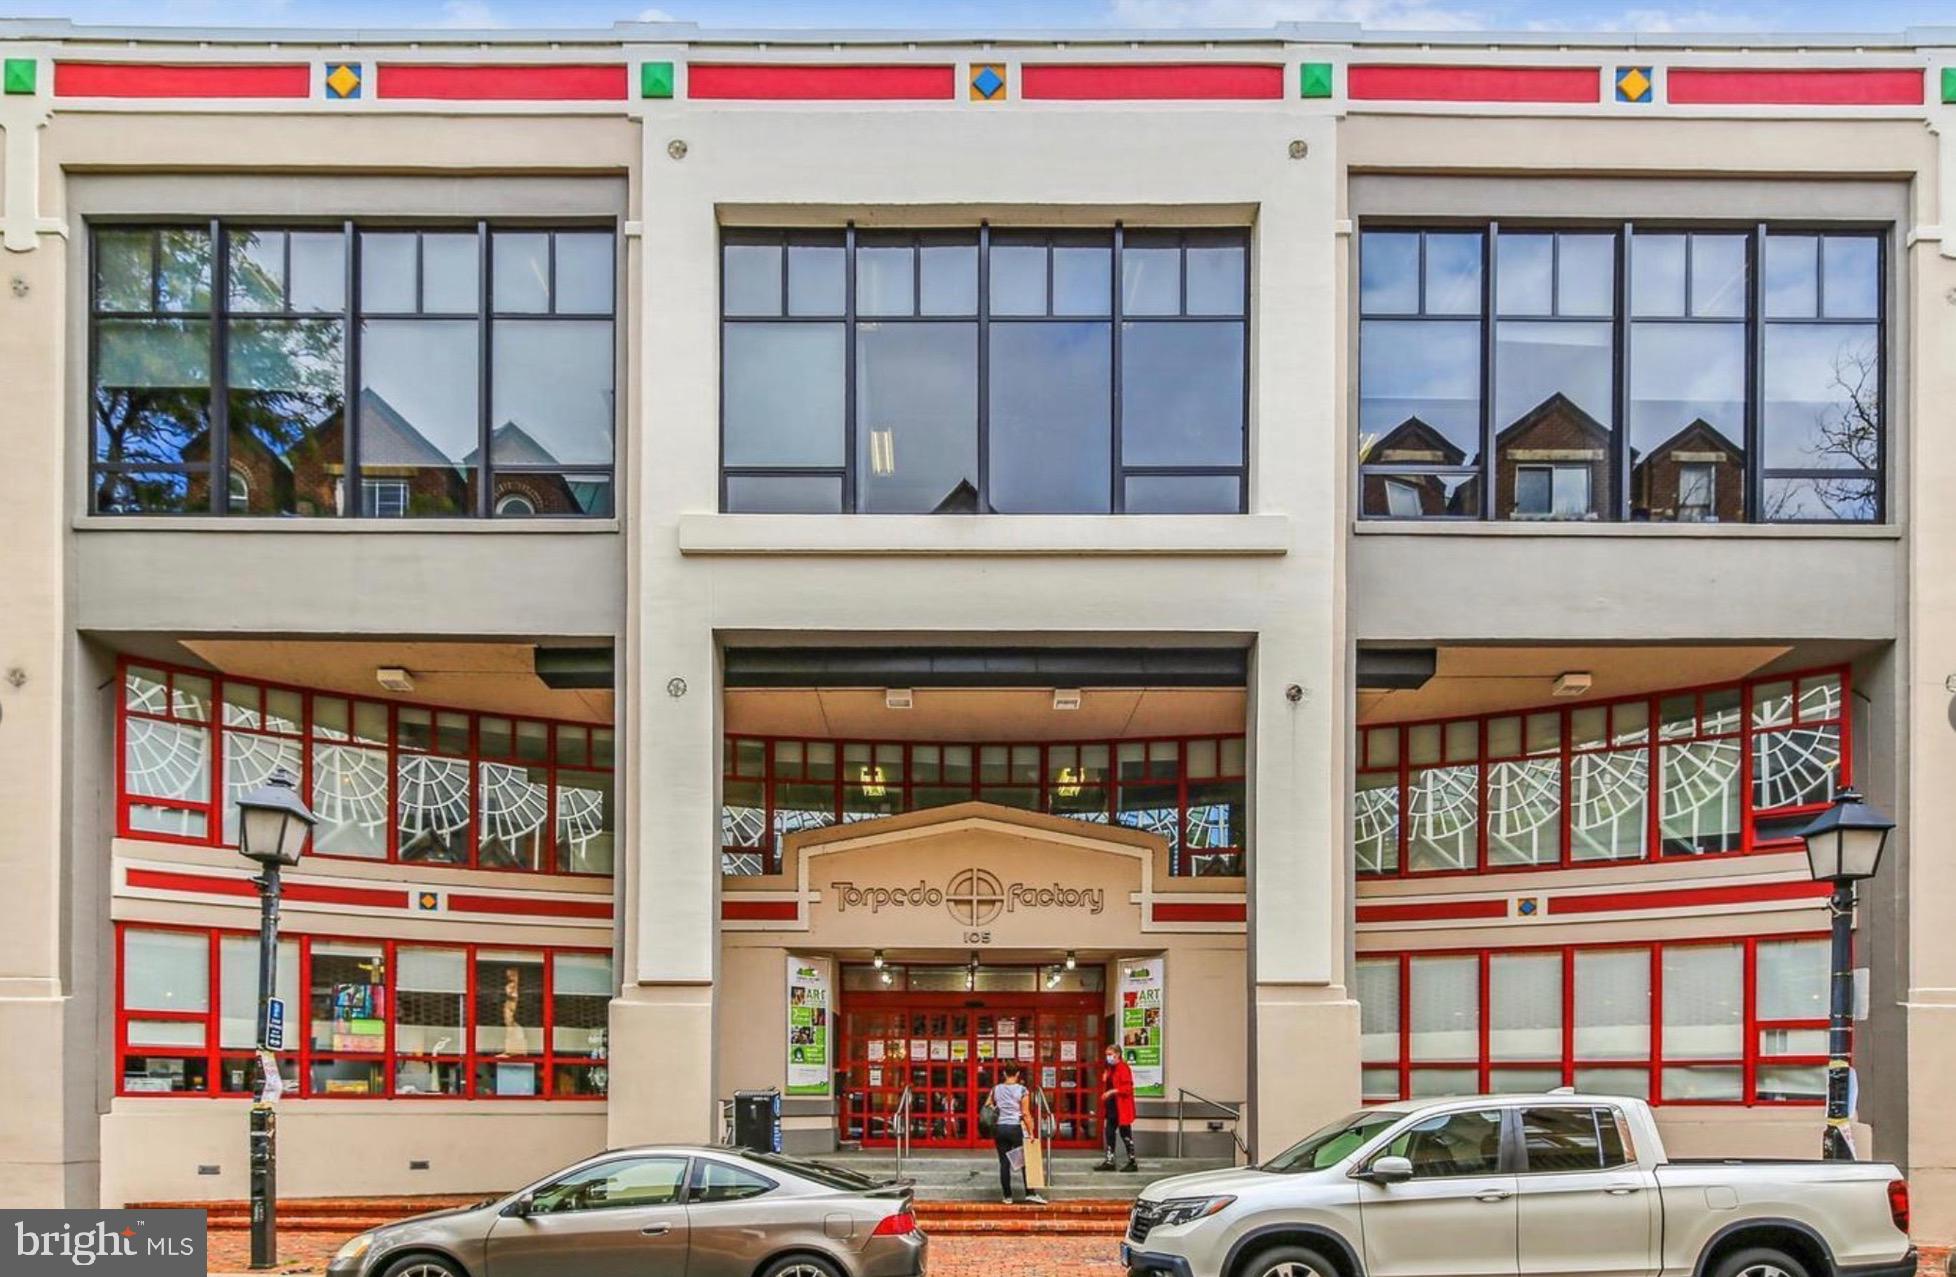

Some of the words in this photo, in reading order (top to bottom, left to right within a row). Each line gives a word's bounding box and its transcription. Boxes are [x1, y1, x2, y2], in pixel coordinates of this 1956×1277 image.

[831, 880, 943, 914] Torpedo
[963, 931, 991, 944] 105
[1139, 988, 1160, 1001] ART
